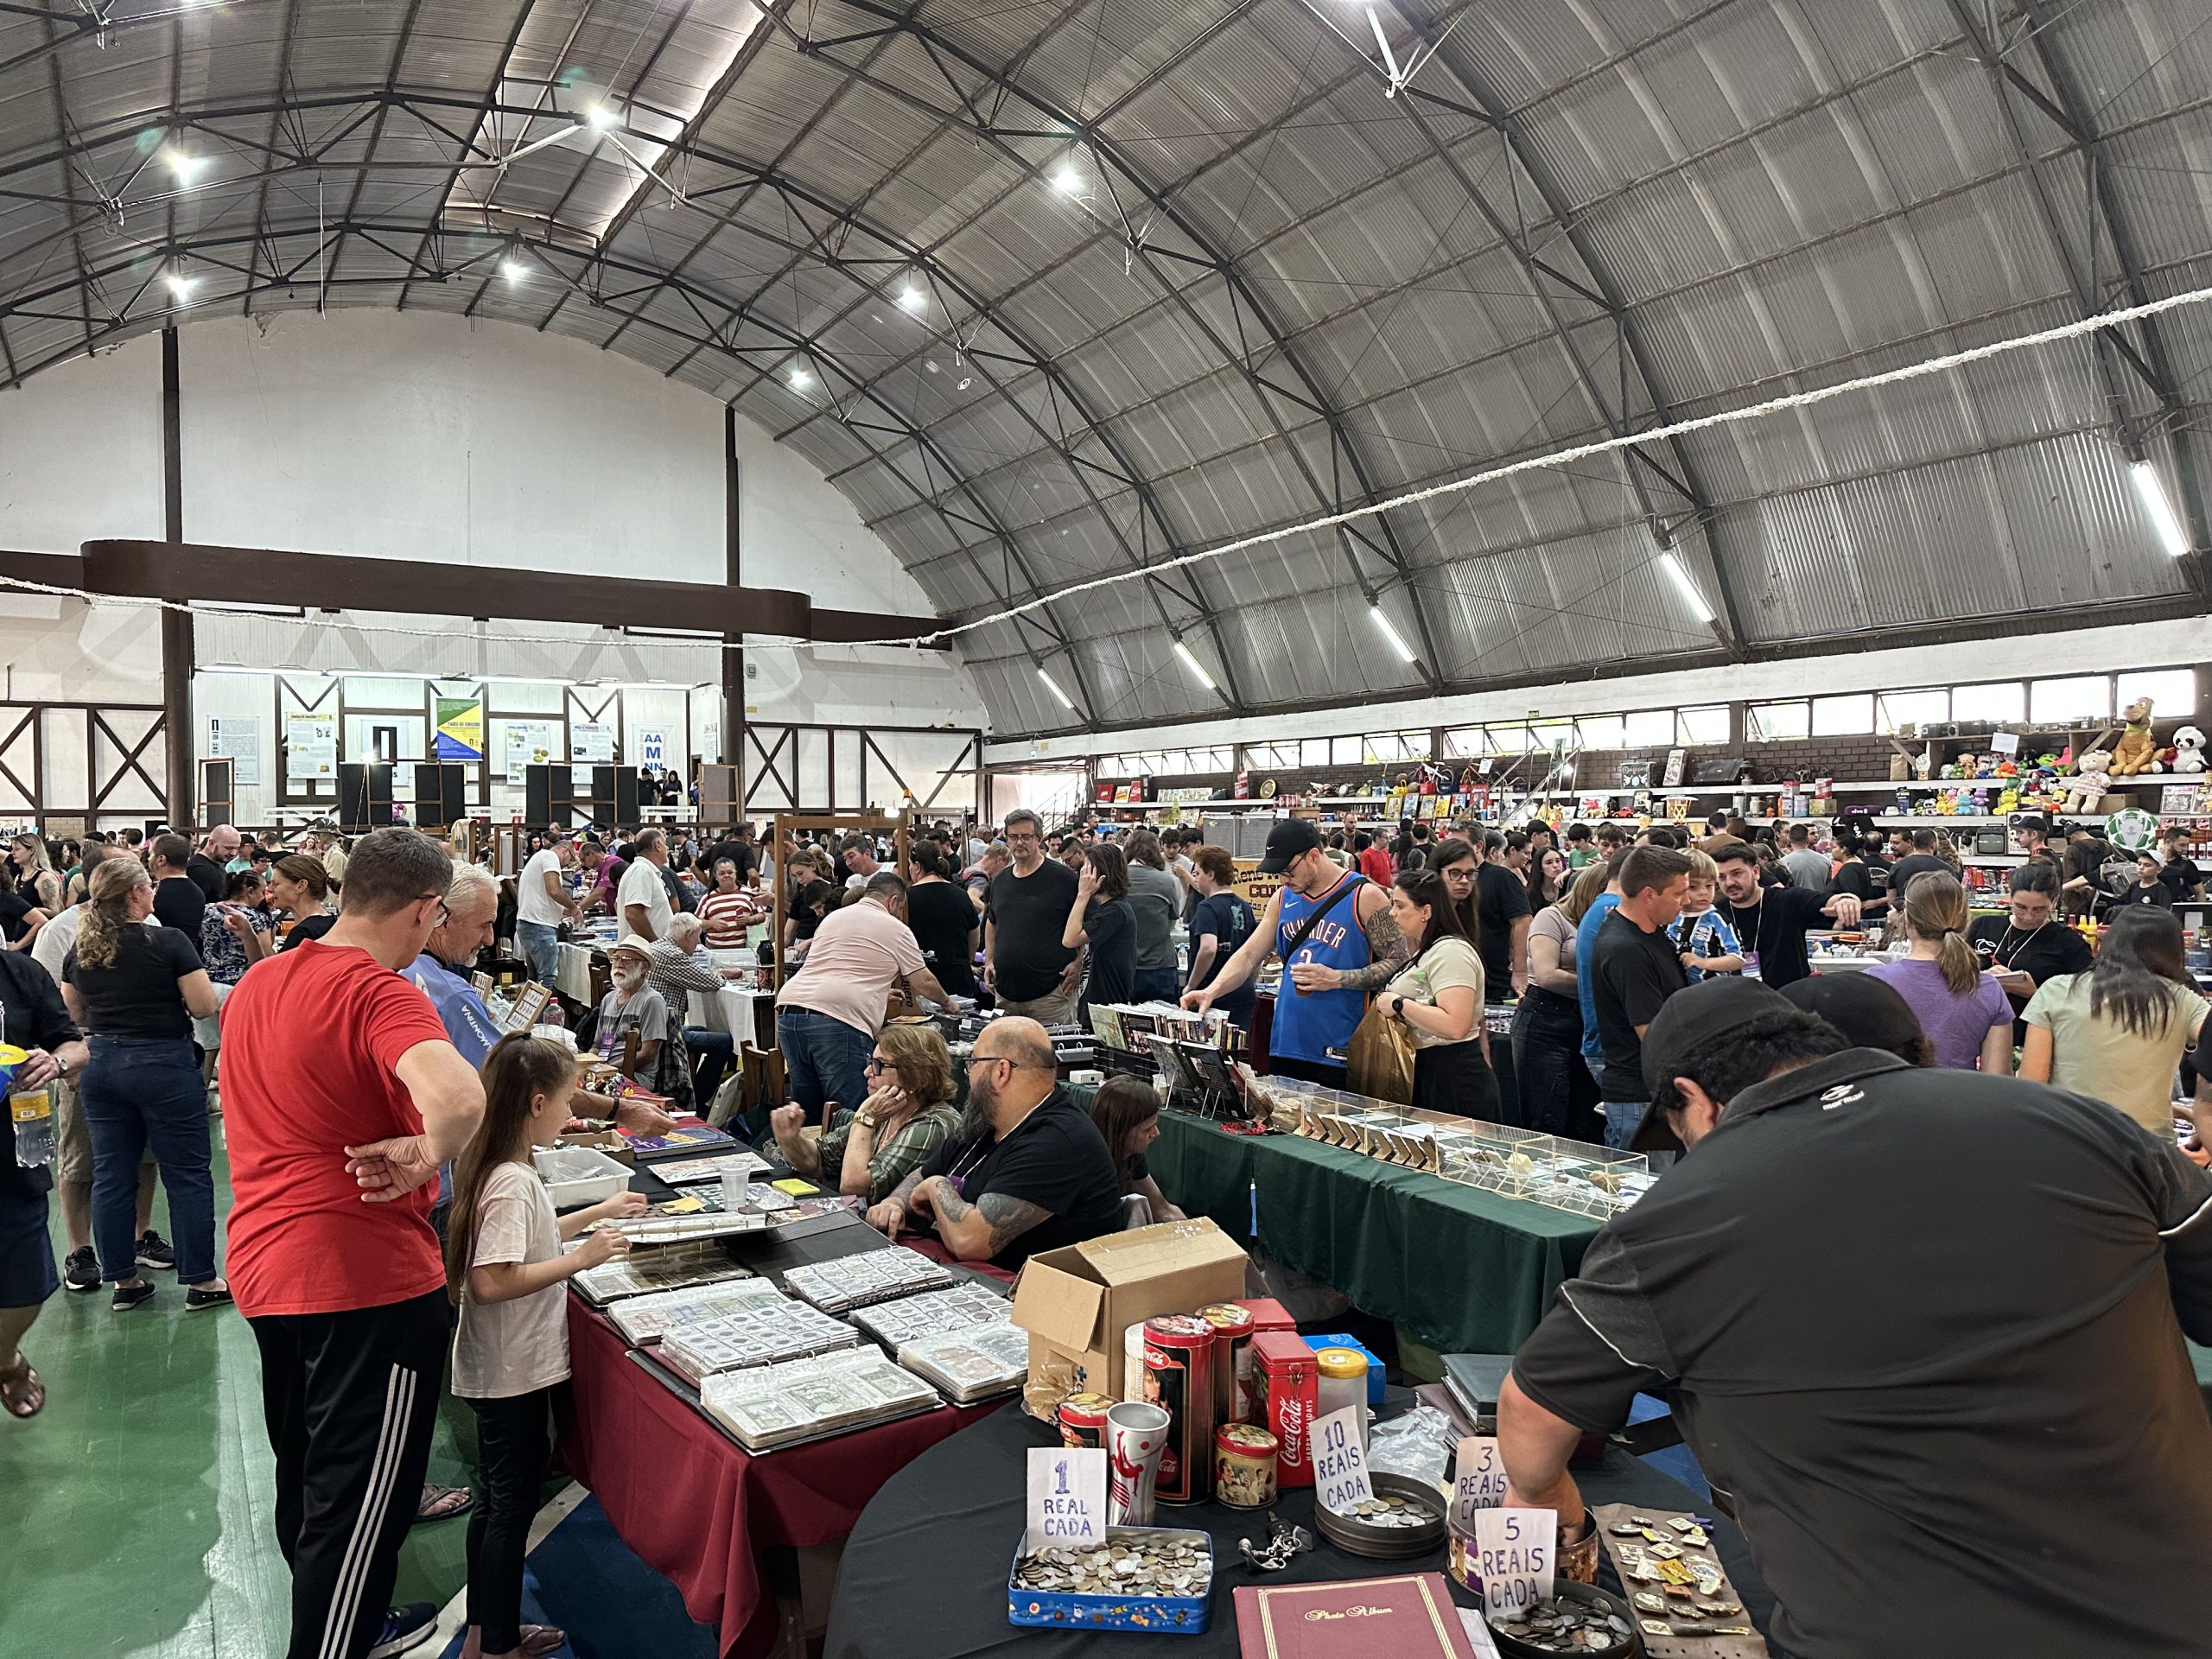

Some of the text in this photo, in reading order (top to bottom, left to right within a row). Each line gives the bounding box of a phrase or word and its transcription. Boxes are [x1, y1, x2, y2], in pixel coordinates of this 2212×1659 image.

[644, 734, 662, 743] AA
[646, 747, 660, 759] M
[1279, 1395, 1302, 1466] Coca-Cola
[1325, 1421, 1344, 1452] 10
[1319, 1446, 1360, 1480] REAIS
[1478, 1446, 1493, 1471] 3
[1055, 1459, 1070, 1494] 1
[1460, 1473, 1507, 1497] REAIS
[1327, 1476, 1366, 1508] CADA
[1044, 1498, 1088, 1515] REAL
[1045, 1518, 1092, 1536] CADA
[1505, 1516, 1521, 1541] 5
[1483, 1548, 1544, 1577] REAIS
[1491, 1578, 1539, 1608] CADA
[1305, 1605, 1393, 1621] Photo Album
